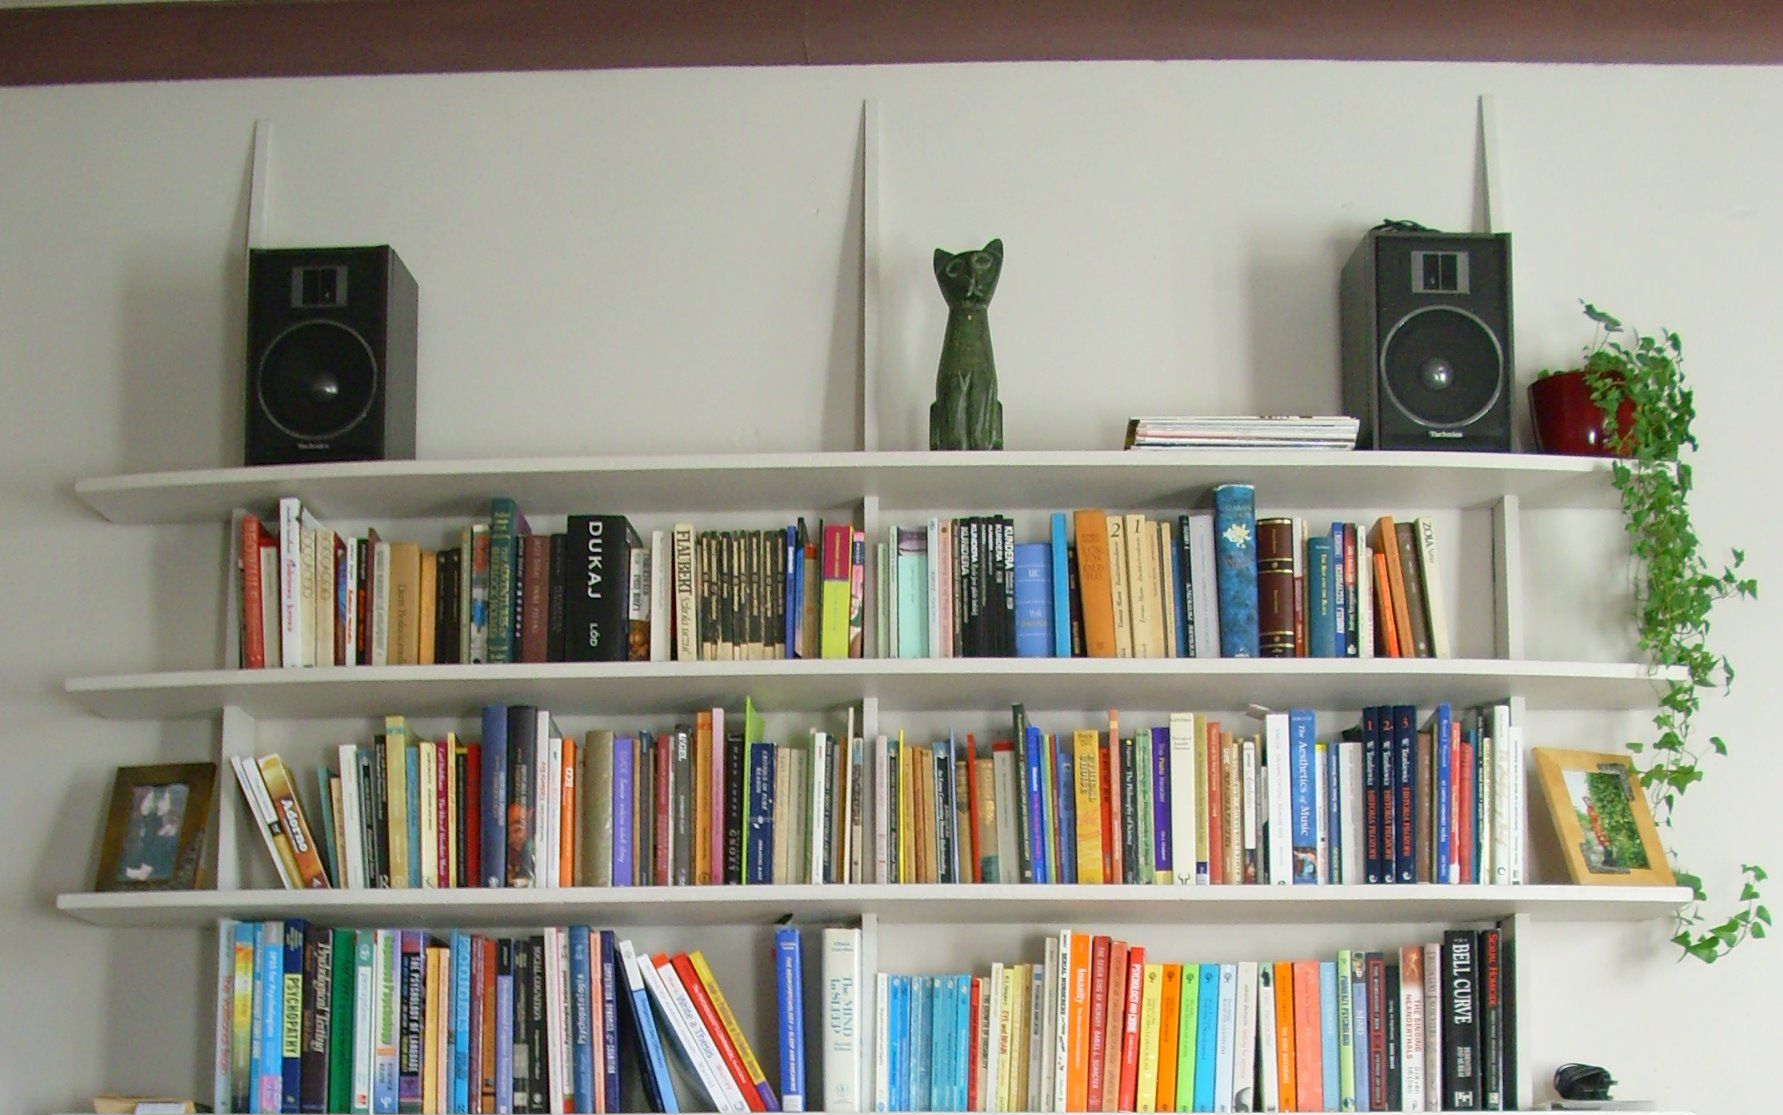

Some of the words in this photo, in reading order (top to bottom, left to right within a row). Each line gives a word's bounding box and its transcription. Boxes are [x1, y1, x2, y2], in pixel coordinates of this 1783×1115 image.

[960, 526, 970, 576] KUNDERA
[970, 524, 979, 563] KUNDERA
[995, 524, 1004, 561] KUNDERA
[1005, 526, 1014, 569] KUNDERA
[1422, 522, 1436, 548] ZOLA
[587, 521, 603, 599] DUKAJ
[676, 530, 693, 596] FLAUBERT
[1298, 725, 1306, 738] The
[1299, 741, 1310, 793] Aesthetics
[1298, 795, 1308, 805] of
[280, 800, 308, 853] Adorno
[1301, 806, 1311, 836] Music
[313, 943, 330, 1010] Psychological
[409, 956, 421, 971] THE
[1453, 943, 1471, 976] BELL
[409, 973, 421, 1020] PSYCHOLOGY
[842, 976, 853, 995] The
[1074, 968, 1088, 1004] Insanity
[1130, 963, 1141, 1003] PSYCHOLOGY
[1454, 979, 1472, 1024] CURVE
[285, 977, 300, 1054] PSYCHOPATHY
[409, 1022, 421, 1032] OF
[830, 992, 841, 1034] SLEEP
[842, 999, 853, 1037] MIND
[1405, 994, 1413, 1059] NEANDERTHALS
[1413, 1000, 1421, 1015] THE
[312, 1013, 328, 1053] Testing
[1413, 1018, 1421, 1052] SINGING
[408, 1034, 421, 1072] LANGUAGE
